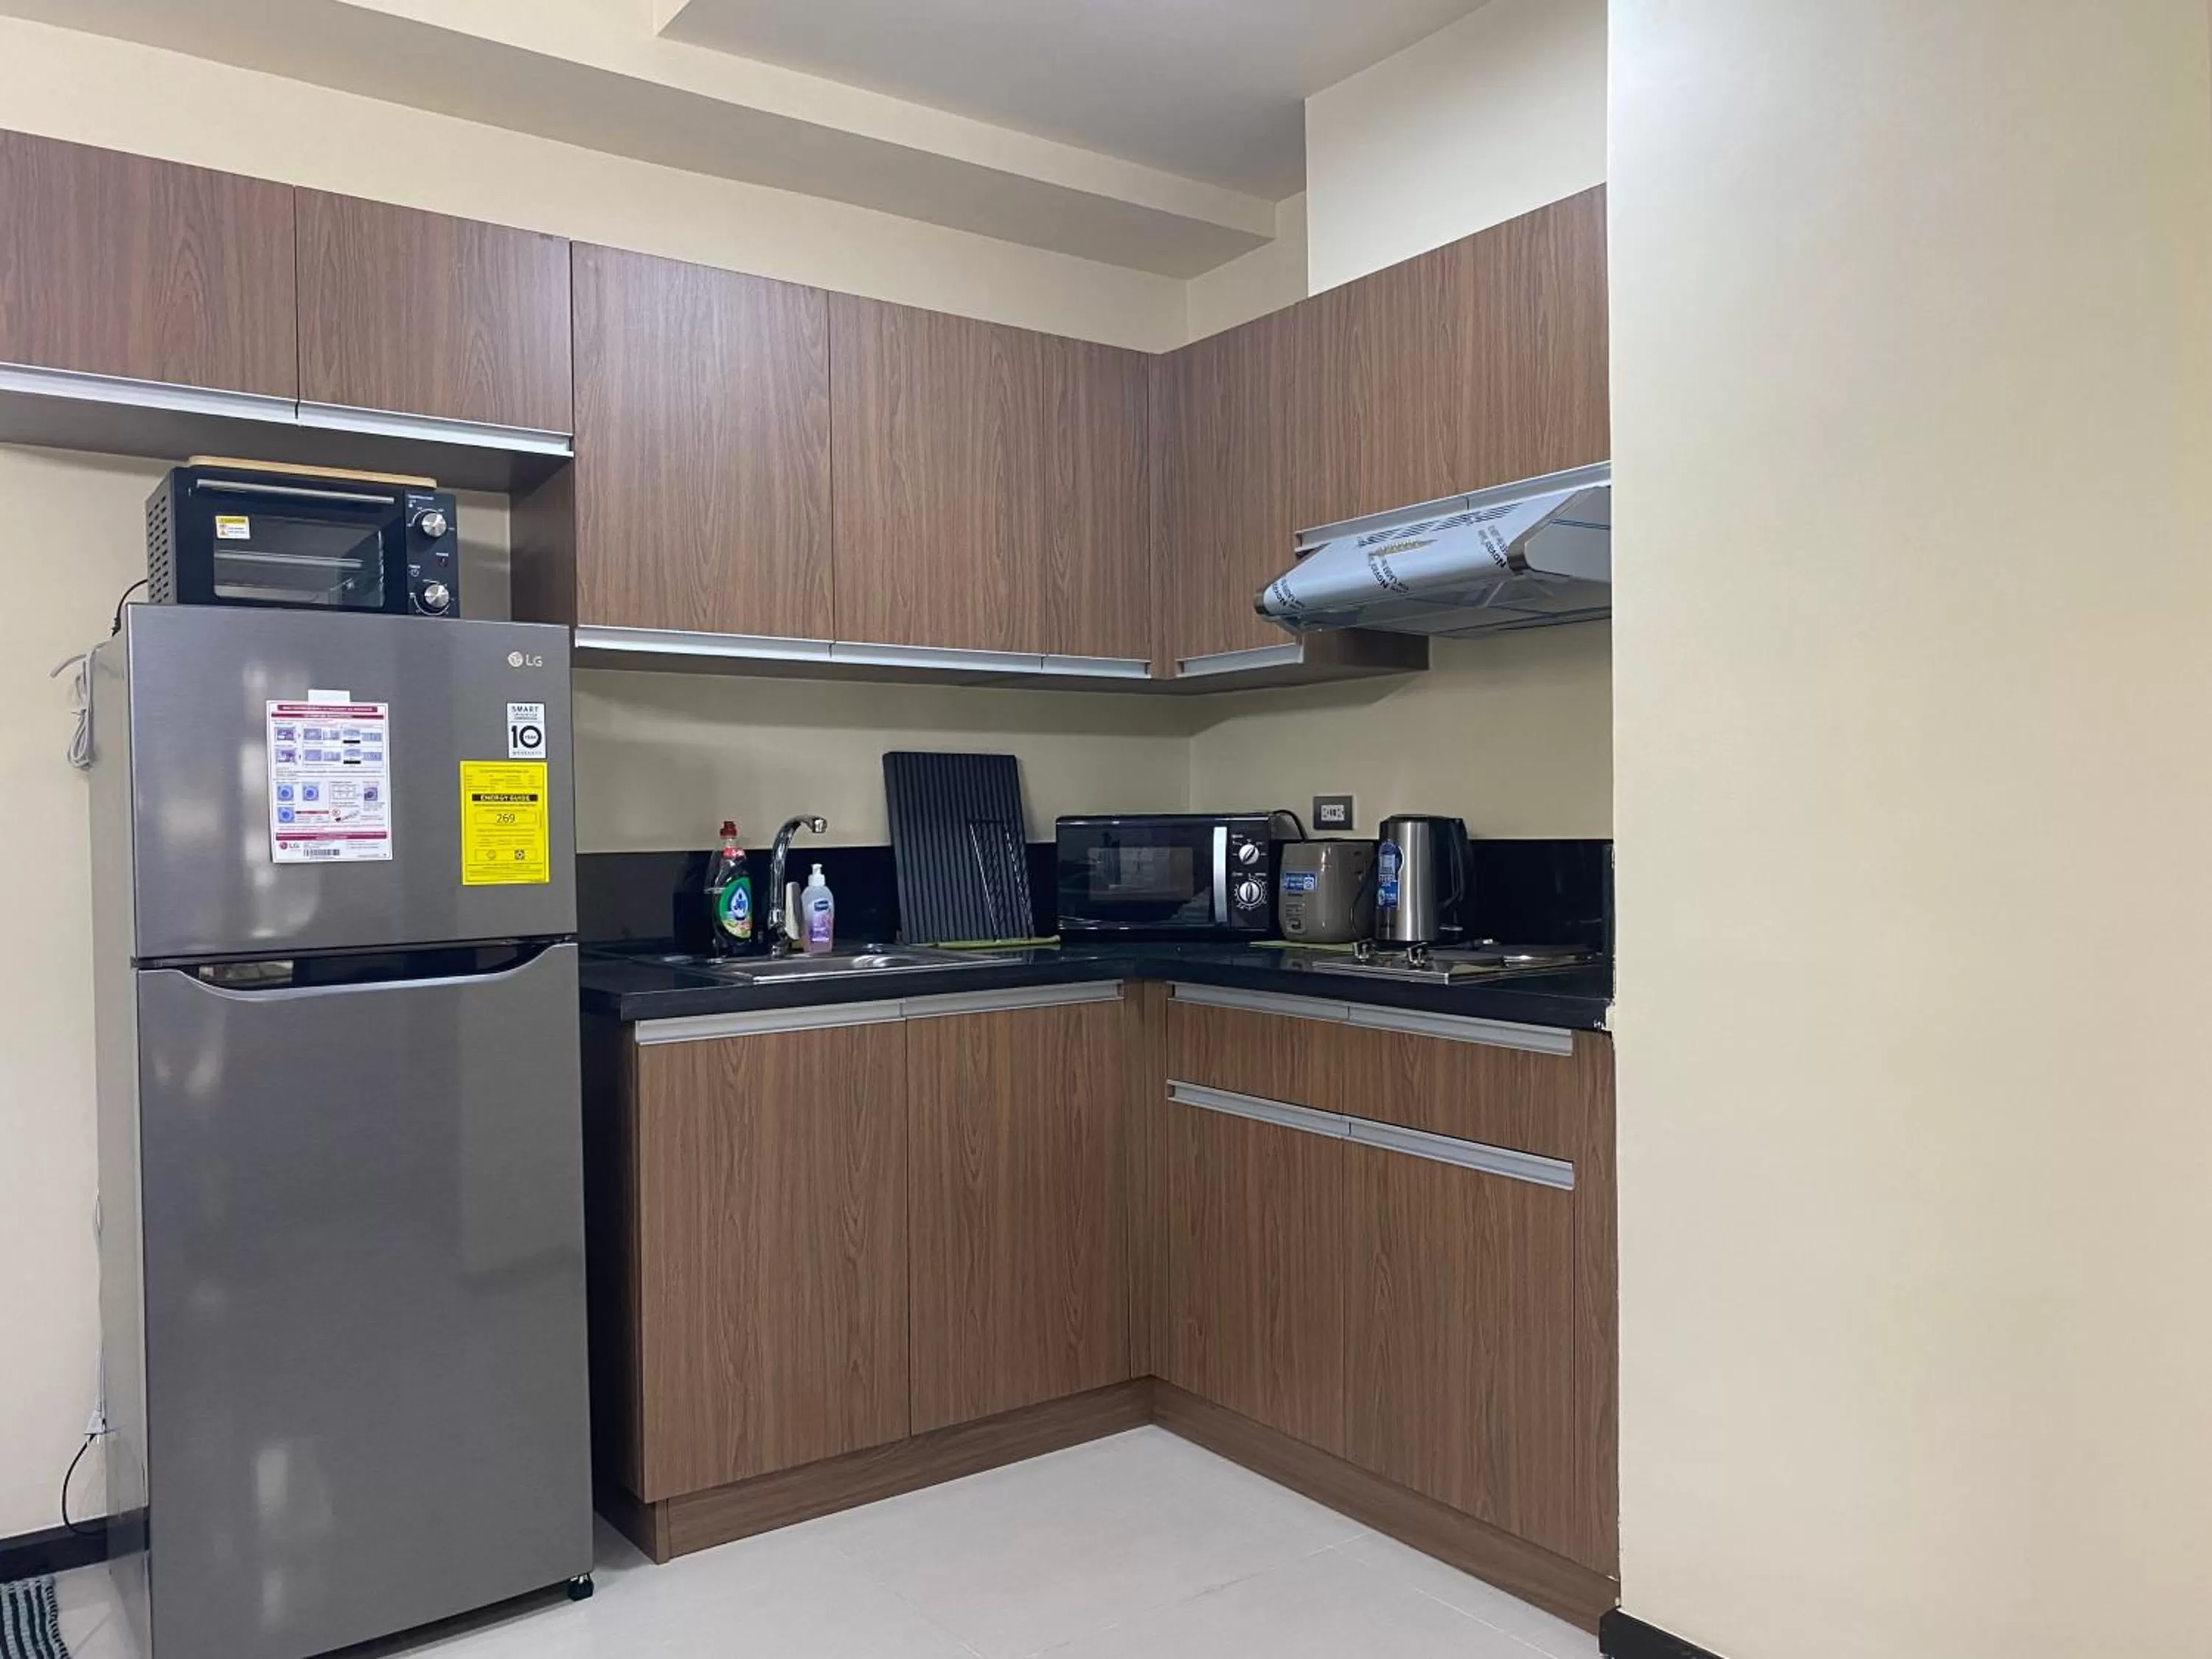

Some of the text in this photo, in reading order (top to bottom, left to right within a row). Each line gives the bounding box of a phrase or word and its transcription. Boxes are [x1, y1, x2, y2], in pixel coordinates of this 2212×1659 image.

[526, 654, 543, 667] LG
[511, 725, 542, 748] 10
[496, 813, 515, 824] 269
